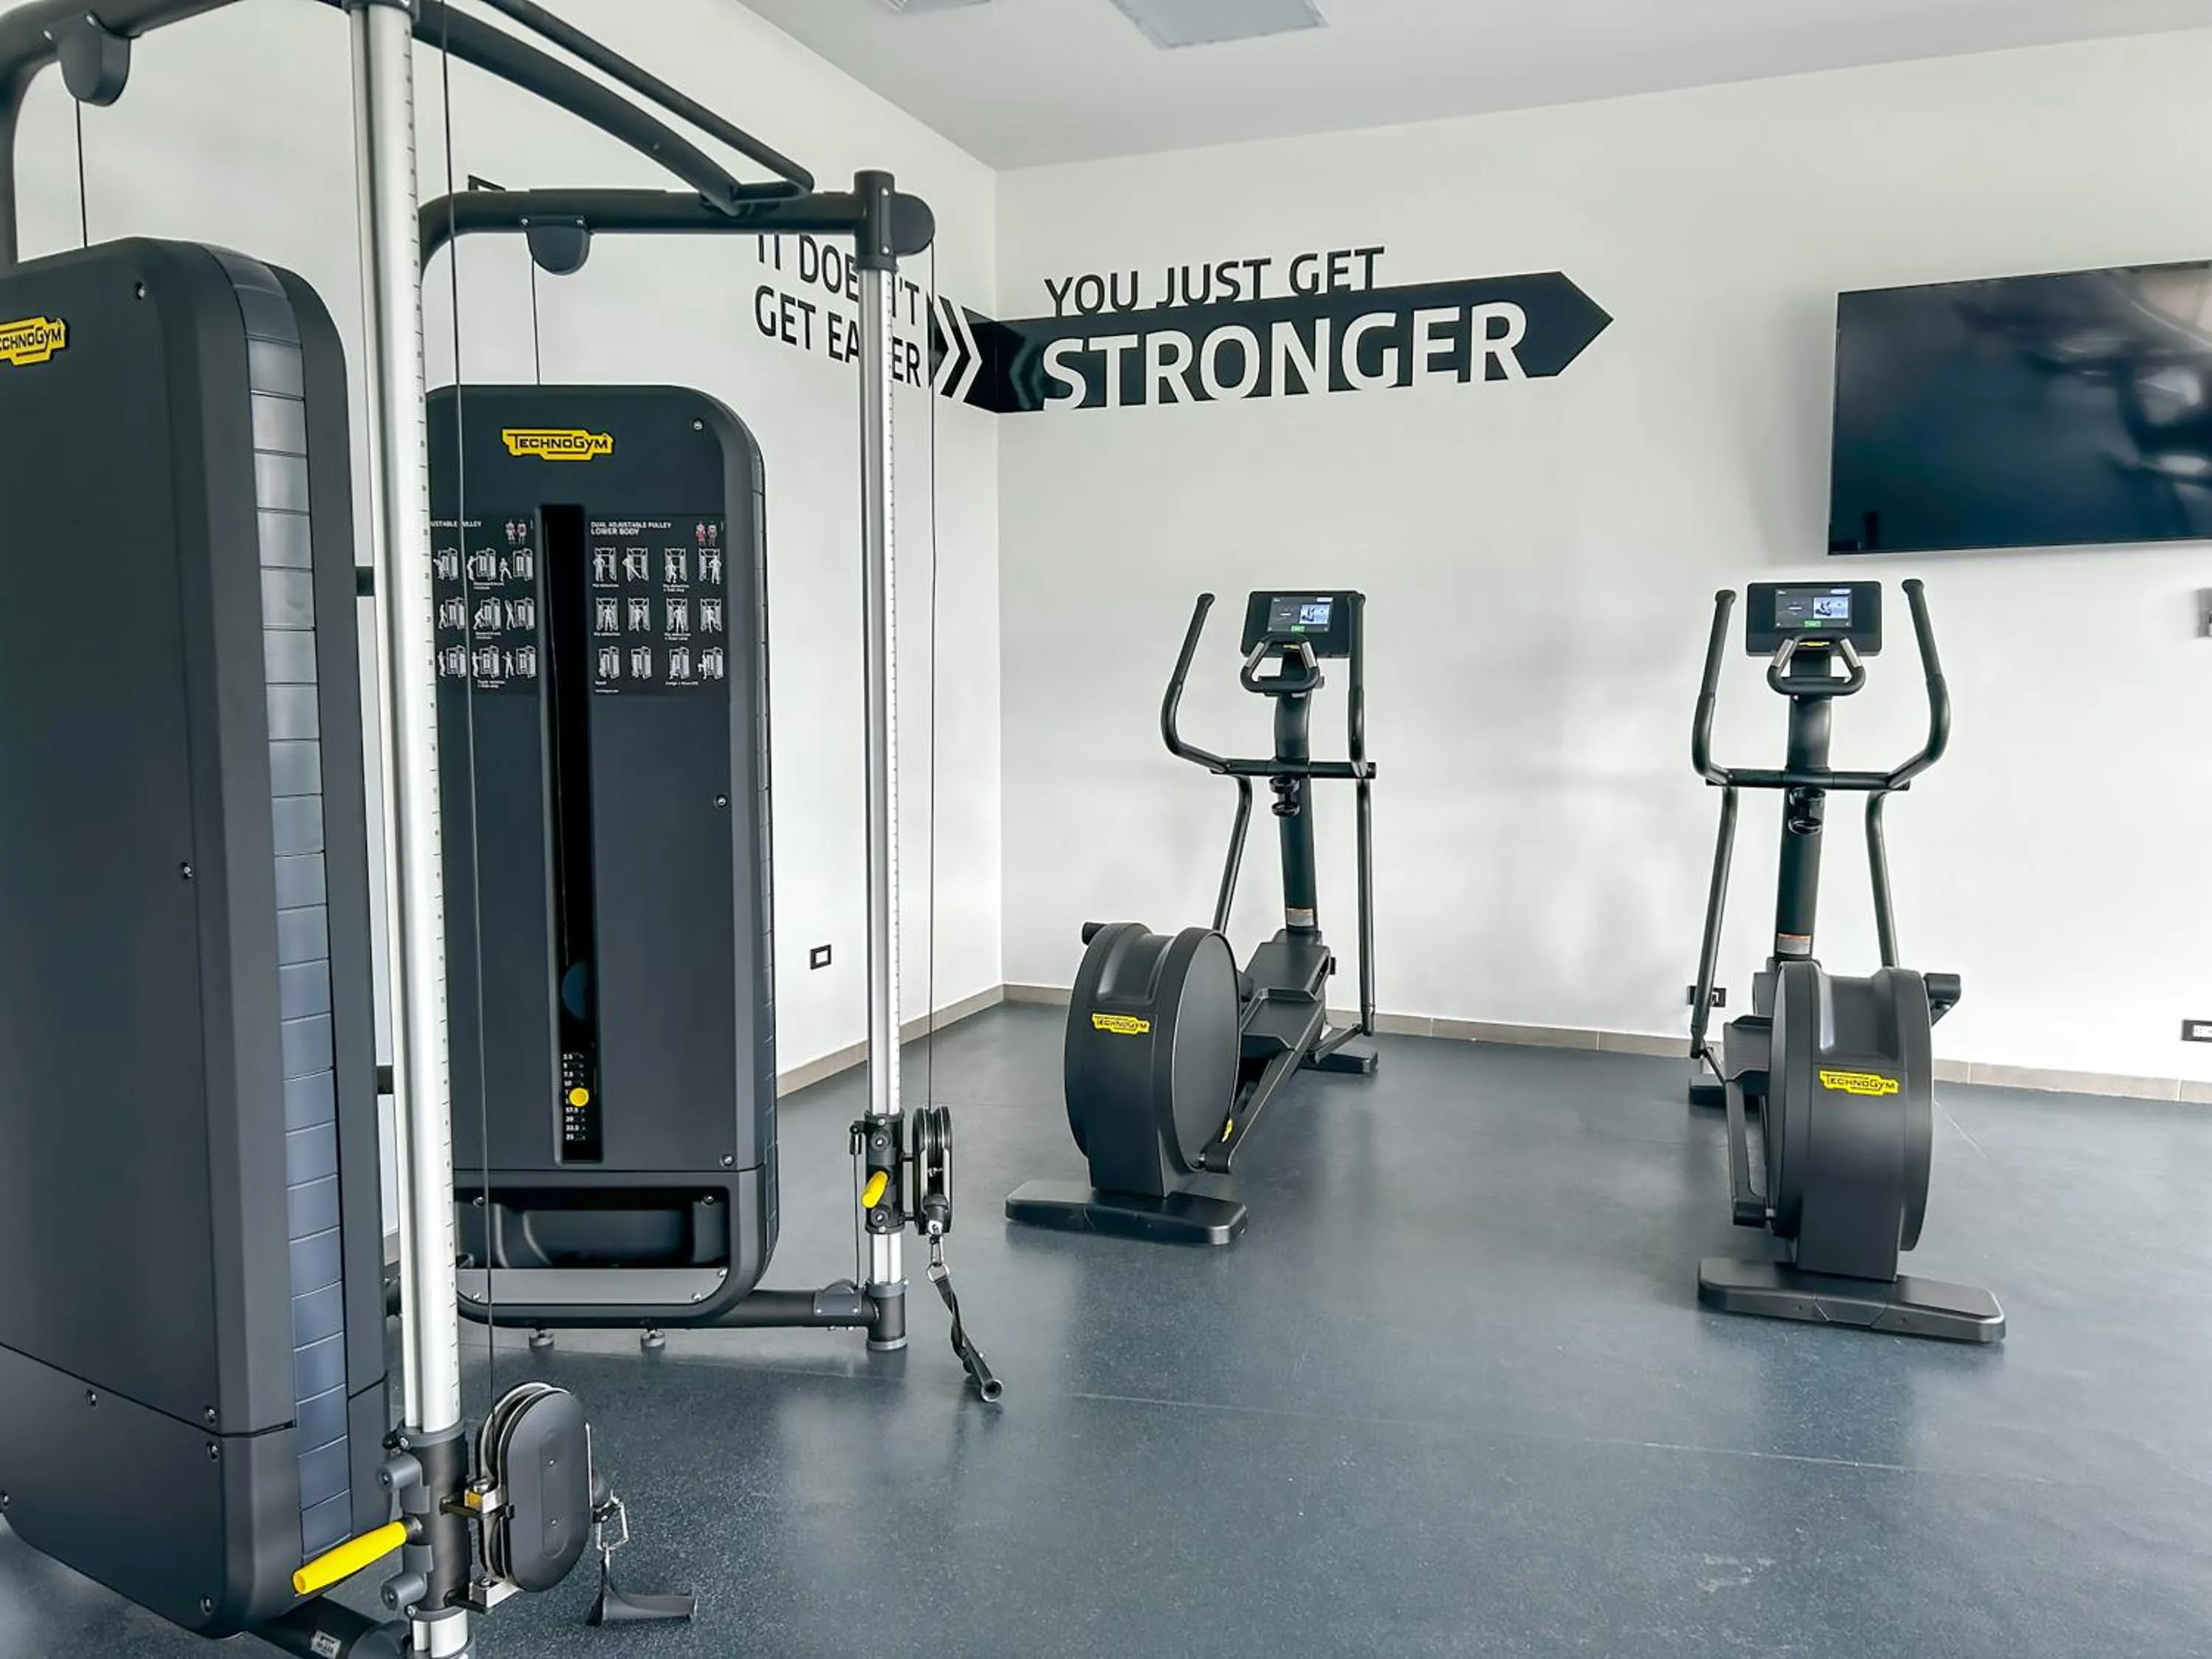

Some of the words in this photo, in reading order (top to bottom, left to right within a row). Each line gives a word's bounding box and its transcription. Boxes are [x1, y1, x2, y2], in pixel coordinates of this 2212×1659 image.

[1043, 270, 1138, 317] YOU
[1156, 258, 1272, 308] JUST
[1289, 246, 1385, 295] GET
[754, 285, 816, 350] GET
[827, 310, 922, 389] EAER
[1041, 301, 1528, 411] STRONGER
